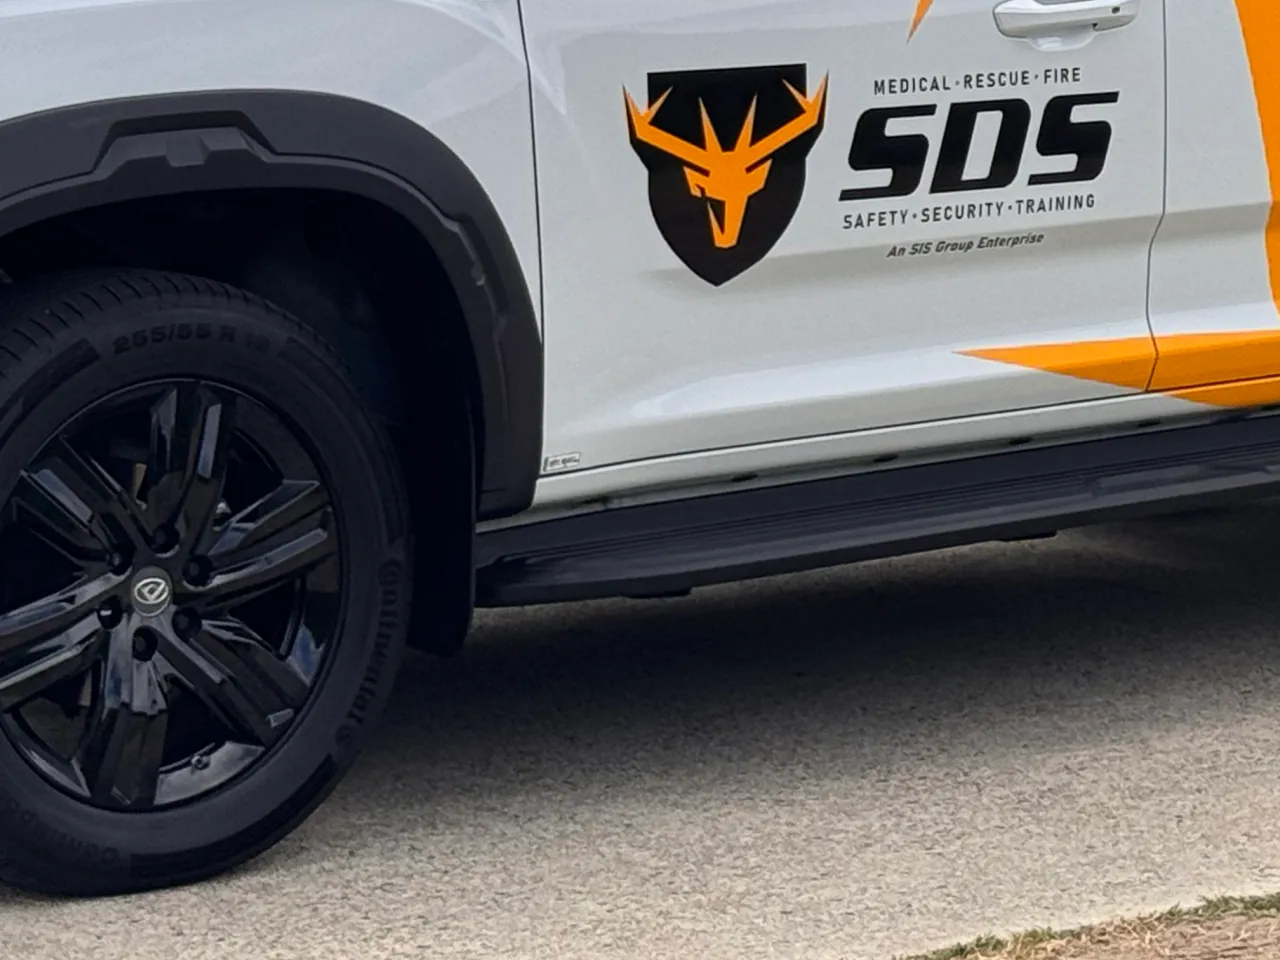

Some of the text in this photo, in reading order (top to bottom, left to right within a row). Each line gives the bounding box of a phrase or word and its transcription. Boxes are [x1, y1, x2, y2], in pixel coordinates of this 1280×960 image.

[838, 90, 1119, 202] SDS
[887, 231, 1045, 258] An SIS Group Enterprise
